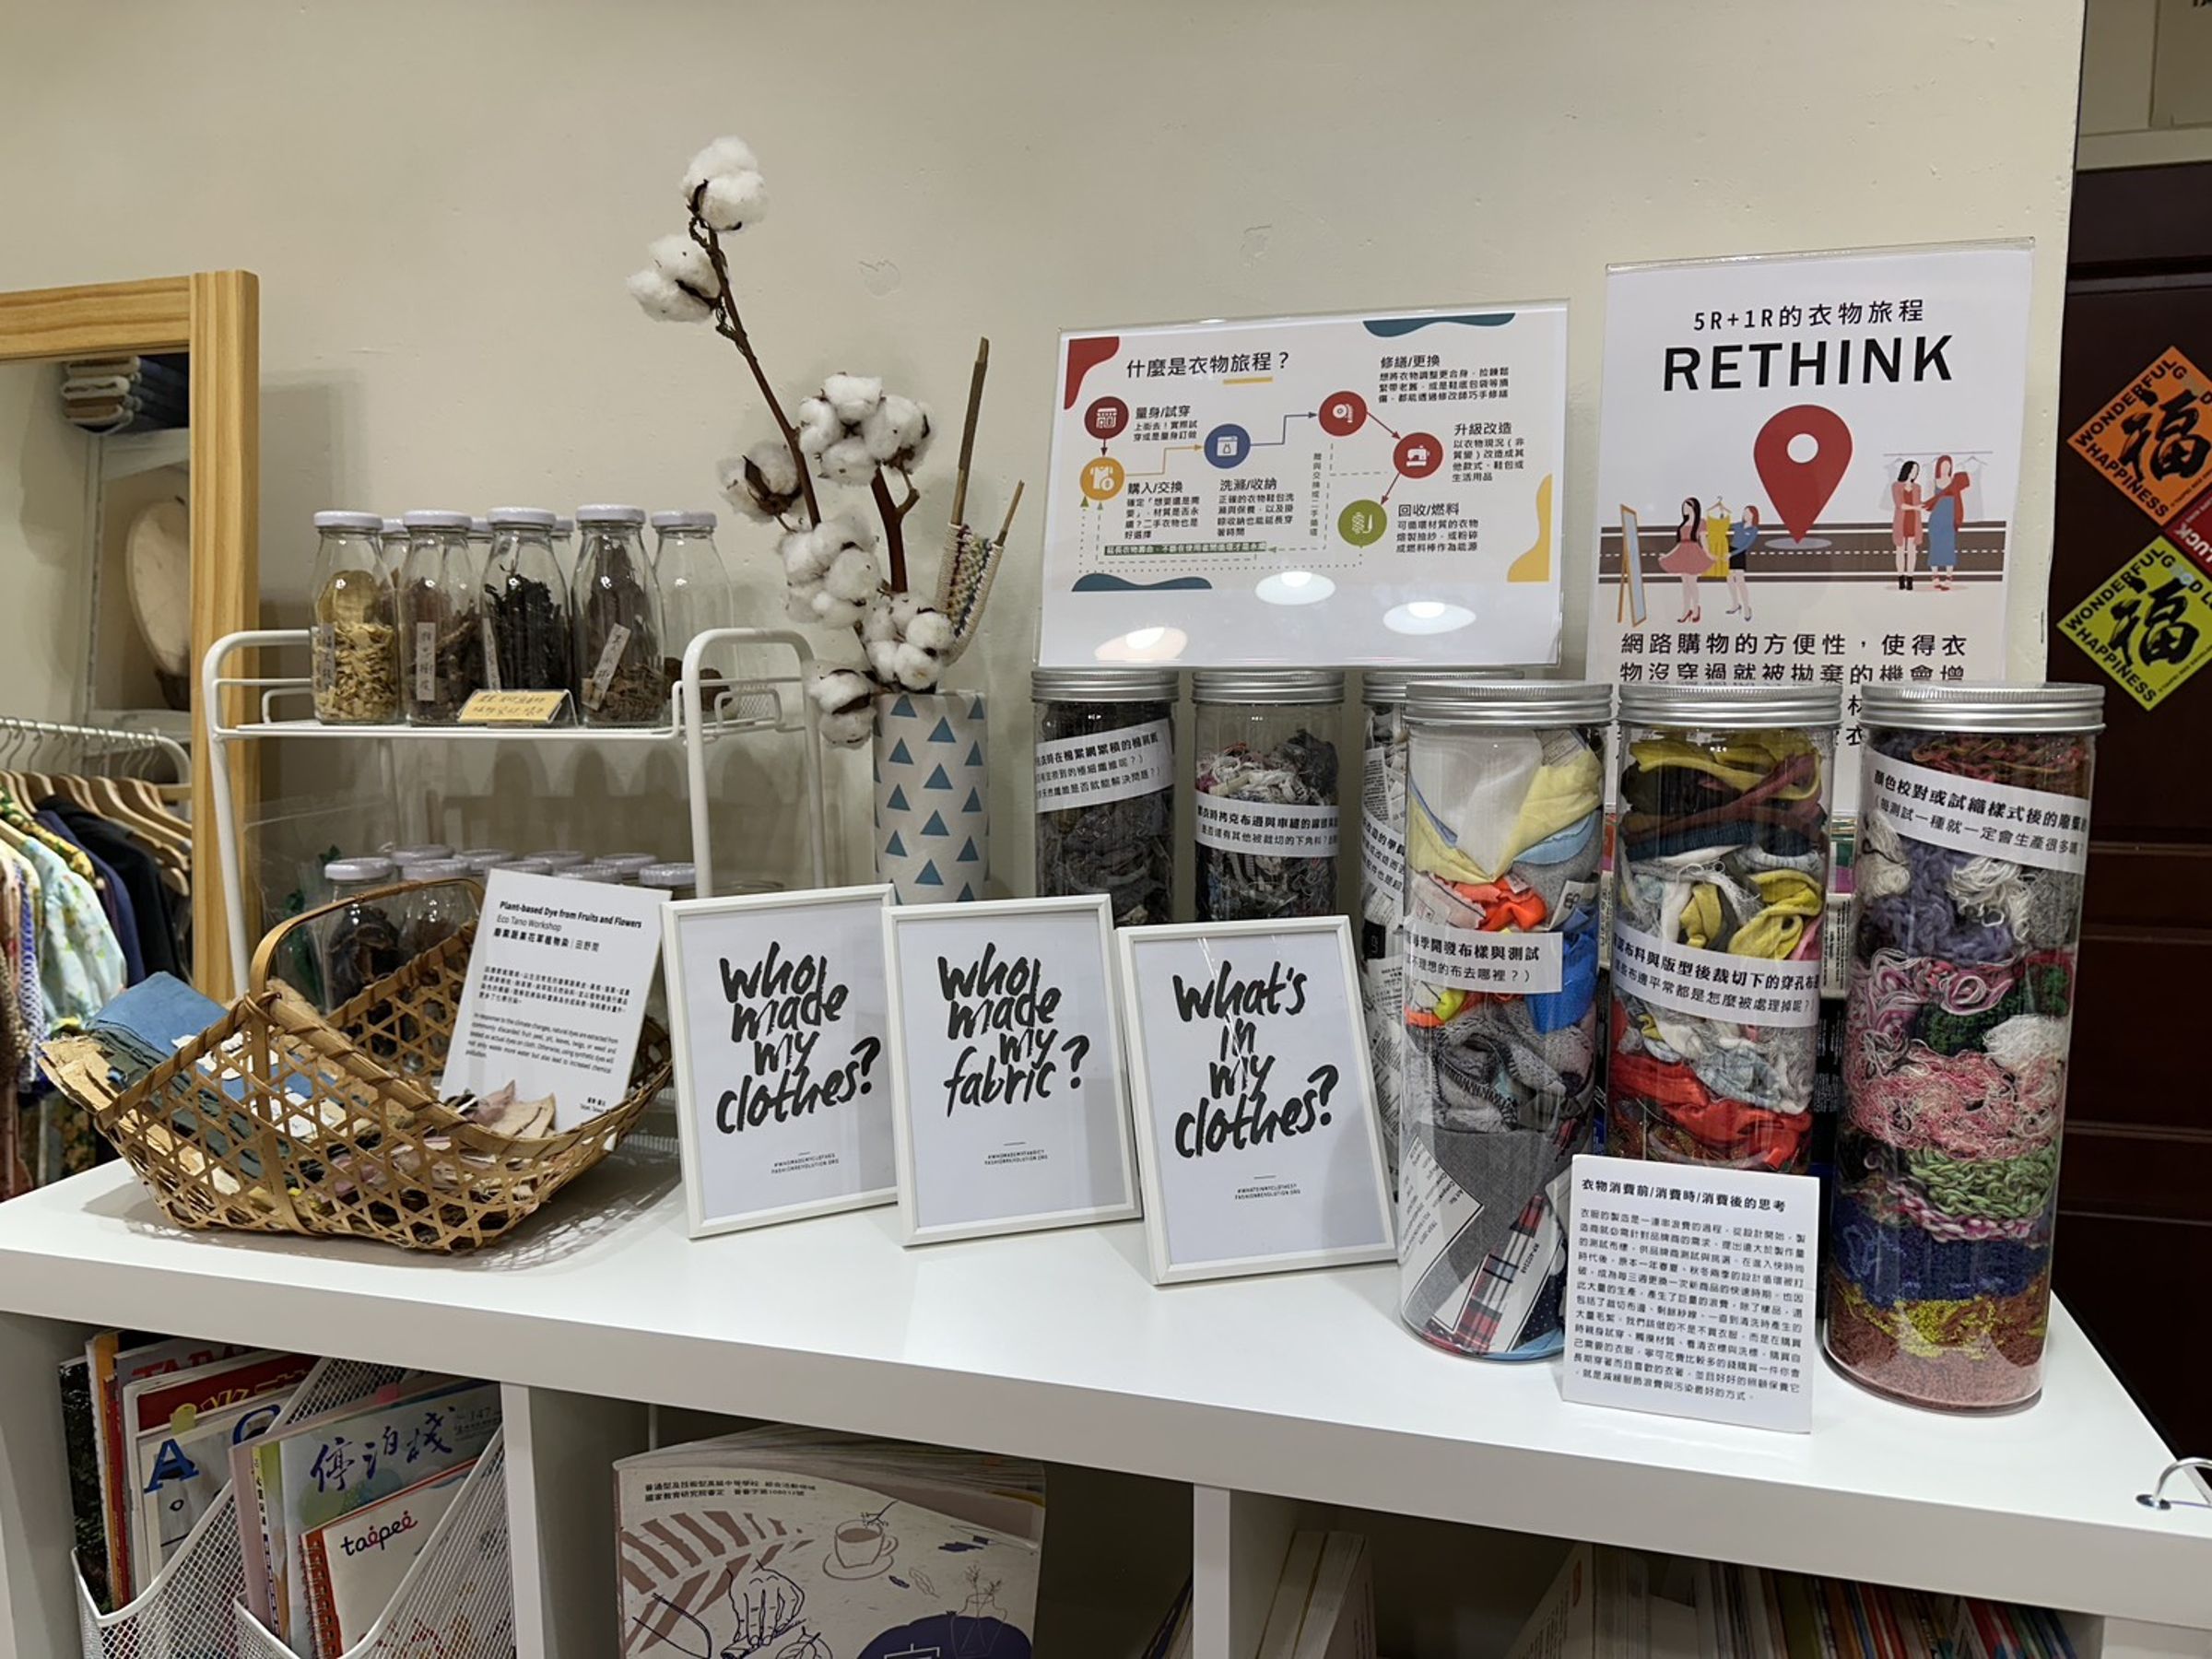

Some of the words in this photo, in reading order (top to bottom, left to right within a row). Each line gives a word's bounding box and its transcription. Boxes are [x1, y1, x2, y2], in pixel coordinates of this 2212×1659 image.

[1693, 298, 1924, 332] 5R+1R的衣物旅程
[1126, 352, 1290, 379] 什麼是衣物旅程？
[1663, 334, 1954, 392] RETHINK
[1135, 405, 1191, 419] 量身/試穿
[2076, 359, 2177, 448] WONDERFUL
[1454, 421, 1512, 436] 升級改造
[2118, 388, 2211, 481] 福
[1127, 480, 1183, 495] 購入/交換
[1219, 477, 1277, 492] 洗滌/收納
[1452, 472, 1493, 483] 生活用品
[2086, 441, 2170, 518] HAPPINESS
[1398, 502, 1460, 517] 回收/燃料
[2065, 548, 2166, 632] WONDERFUL
[2109, 575, 2200, 667] 福
[1620, 632, 1967, 656] 網路購物的方便性，使得衣
[2076, 628, 2157, 703] HAPPINESS
[497, 914, 510, 924] Eco
[528, 919, 562, 932] Workshop
[500, 900, 543, 915] Plant-based
[544, 907, 558, 918] Dye
[559, 909, 577, 920] from
[578, 912, 598, 923] Fruits
[600, 914, 613, 924] and
[615, 916, 642, 929] Flowers
[731, 957, 848, 1042] made
[947, 957, 1062, 1040] made
[753, 1030, 820, 1077] my
[999, 1027, 1058, 1067] my
[1220, 1016, 1256, 1061] in
[715, 1035, 881, 1135] clothes?
[1208, 1053, 1277, 1102] my
[1174, 1064, 1339, 1158] clothes?
[1581, 1178, 1786, 1213] 衣物消費前/消費時/消費後的思考
